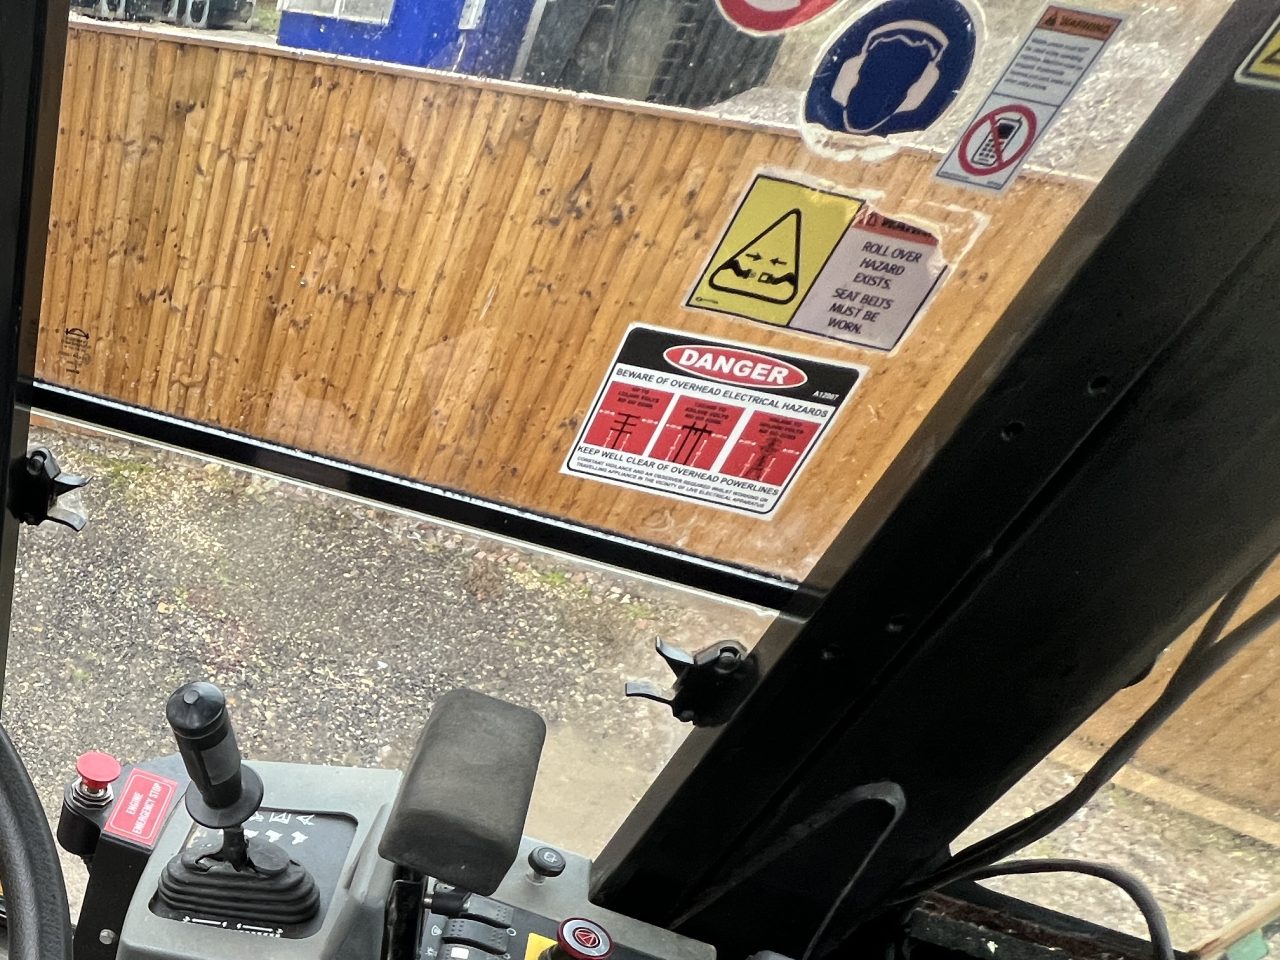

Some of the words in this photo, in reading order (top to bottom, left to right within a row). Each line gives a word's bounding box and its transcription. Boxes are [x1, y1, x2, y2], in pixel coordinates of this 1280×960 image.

[861, 241, 889, 257] ROLL
[891, 248, 922, 263] OVER
[859, 257, 906, 276] HAZARD
[852, 272, 892, 290] EXISTS.
[832, 287, 862, 301] SEAT
[860, 293, 894, 310] BELTS
[828, 302, 862, 318] MUST
[862, 310, 880, 323] BE
[827, 317, 861, 335] WORN.
[679, 349, 789, 385] DANGER
[616, 368, 654, 383] BEWARE
[655, 376, 670, 384] OF
[670, 379, 722, 396] OVERHEAD
[722, 390, 782, 409] ELECTRICAL
[782, 402, 829, 418] HAZARDS
[578, 446, 601, 456] KEEP
[602, 450, 624, 462] WELL
[626, 456, 656, 469] CLEAR
[656, 463, 671, 471] OF
[670, 466, 720, 483] OVERHEAD
[720, 477, 780, 496] POWERLINES
[698, 489, 732, 502] ELECTRICAL
[126, 792, 144, 815] ENGINE
[132, 797, 155, 834] EMERGENCY
[149, 782, 162, 799] STOP
